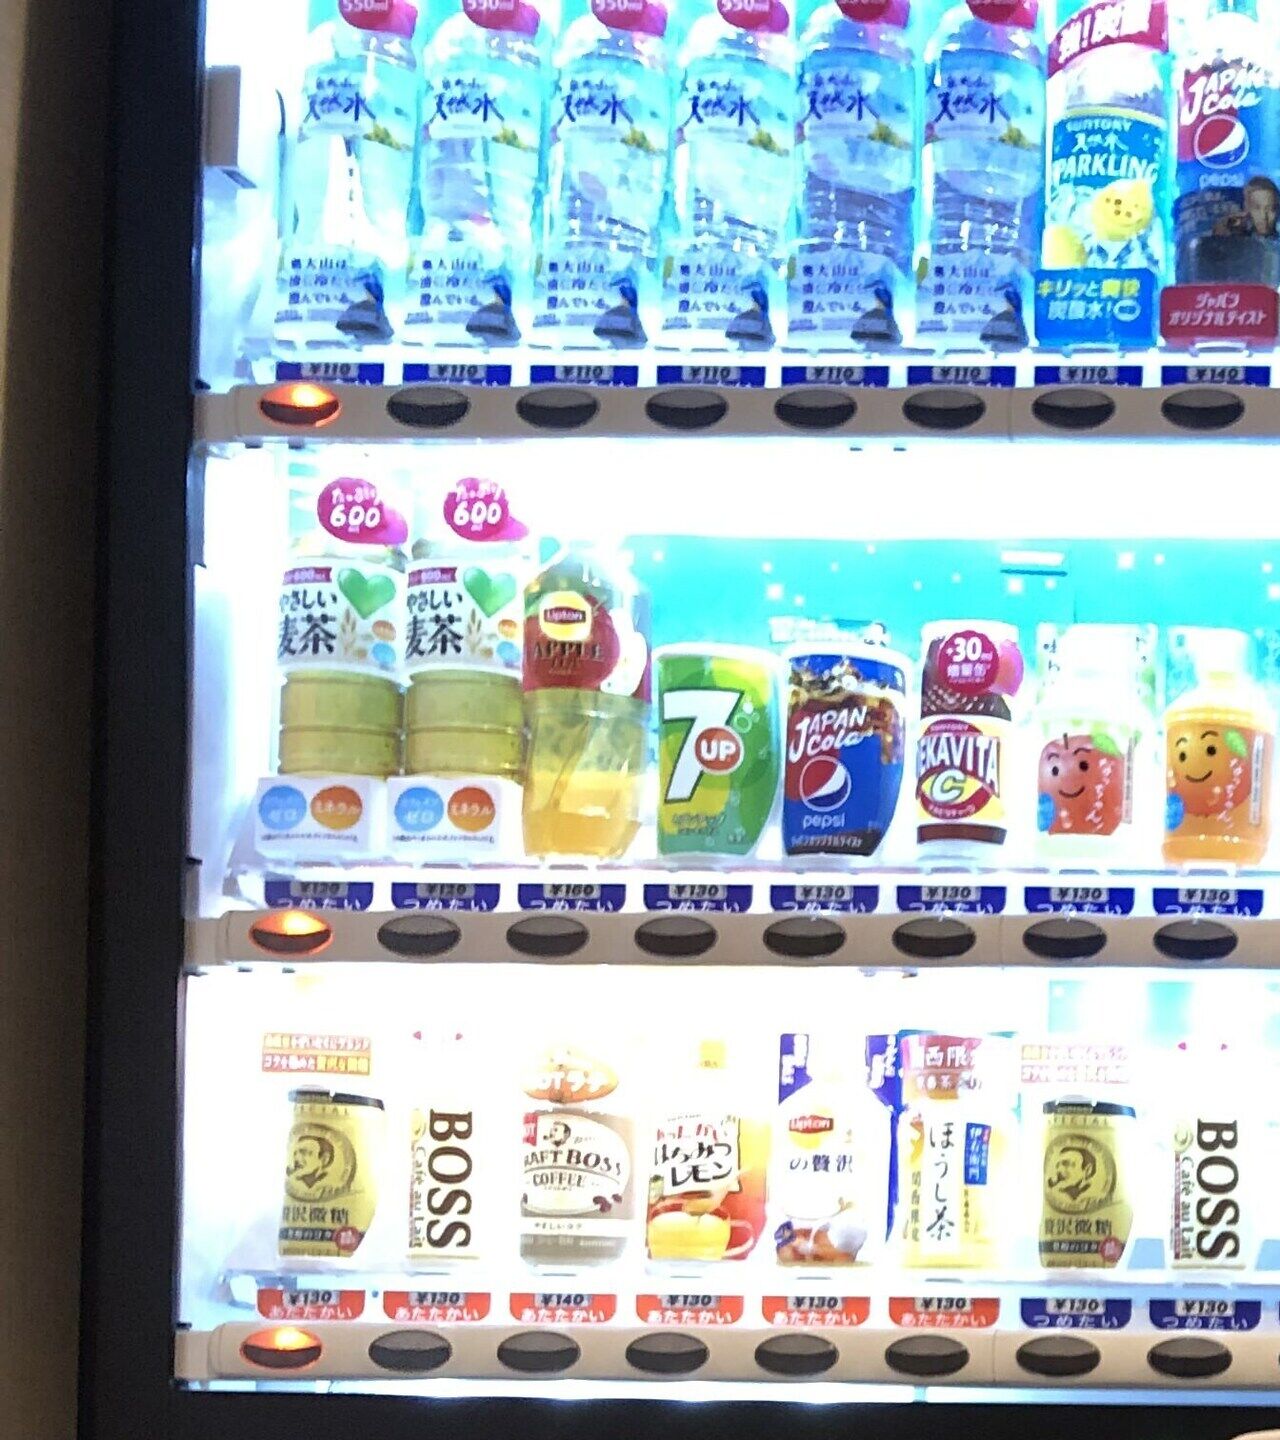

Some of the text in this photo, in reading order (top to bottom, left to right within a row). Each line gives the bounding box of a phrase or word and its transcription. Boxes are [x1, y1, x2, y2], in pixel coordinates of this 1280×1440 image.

[330, 504, 381, 528] 600
[453, 500, 502, 526] 600
[663, 688, 744, 804] 7
[700, 739, 737, 760] UP
[803, 814, 845, 830] pepsi
[426, 1109, 473, 1249] BOSS
[671, 1162, 733, 1187] レモン
[1196, 1118, 1240, 1260] BOSS
[269, 1306, 352, 1319] あたたかい
[394, 1307, 479, 1321] あたたかい
[520, 1308, 605, 1323] あたたかい
[647, 1310, 732, 1324] あたたかい
[773, 1311, 858, 1326] あたたかい
[901, 1312, 987, 1327] あたたかい
[1033, 1315, 1118, 1328] つめたい
[1162, 1316, 1247, 1329] つめたい
